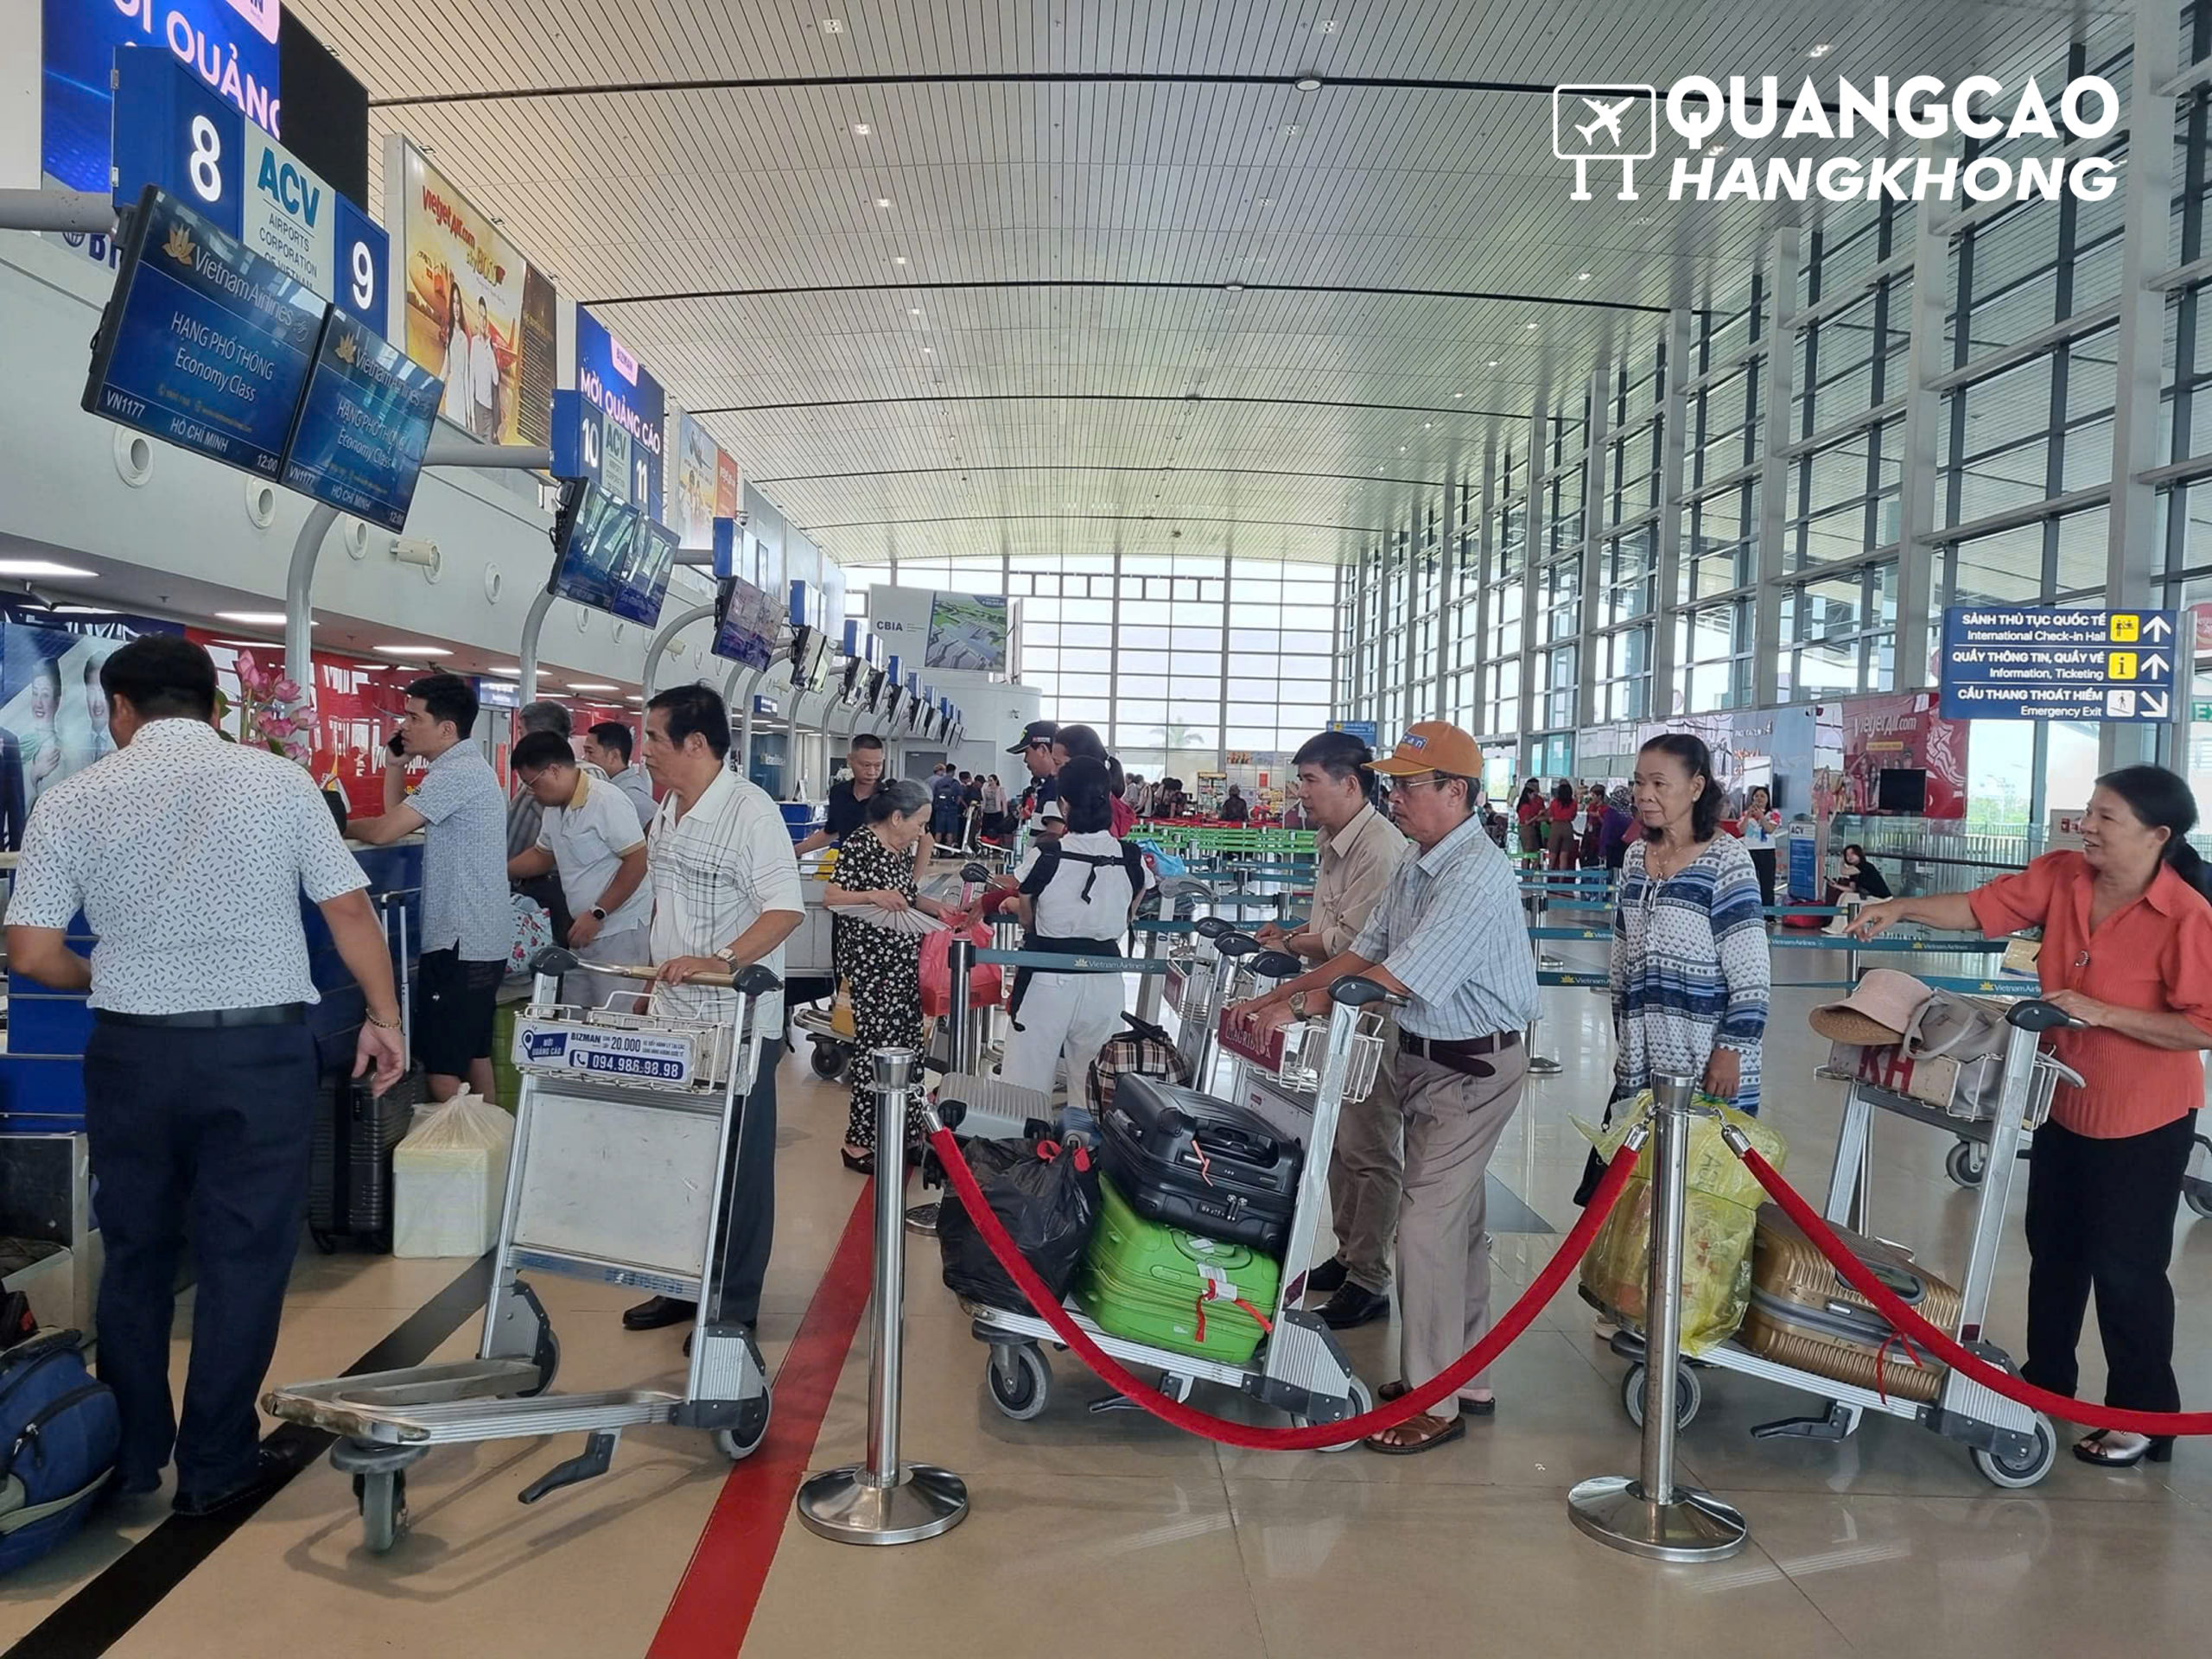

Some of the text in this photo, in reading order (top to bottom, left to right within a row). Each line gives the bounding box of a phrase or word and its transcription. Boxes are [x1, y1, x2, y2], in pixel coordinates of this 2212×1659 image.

[190, 114, 221, 202] 8
[257, 147, 320, 228] ACV
[269, 213, 309, 252] AIRPORTS
[259, 227, 318, 278] CORPORATION
[353, 241, 373, 309] 9
[171, 311, 209, 346] HẠNG
[238, 346, 276, 381] THÔNG
[175, 346, 229, 392] Economy
[229, 374, 257, 402] Class
[106, 390, 146, 419] VN1177
[581, 366, 661, 455] MỜI QUẢNG CÁO
[204, 431, 229, 453] MINH
[337, 429, 392, 468] Economy Class
[582, 417, 599, 468] 10
[606, 423, 627, 461] ACV
[257, 452, 278, 473] 12:00
[636, 459, 647, 504] 11
[876, 620, 903, 632] CBIA
[1967, 630, 2106, 642] International Check-in Hall
[2025, 614, 2053, 629] TỤC
[1987, 651, 2029, 664] THÔNG
[2030, 652, 2052, 665] TIN,
[1990, 668, 2104, 681] Information, Ticketing
[1986, 690, 2028, 701] THANG
[2030, 687, 2072, 701] THOÁT
[2020, 705, 2102, 718] Emergency Exit
[1790, 826, 1804, 835] ACV
[570, 1032, 601, 1044] BIZMAN
[611, 1036, 641, 1052] 20.000
